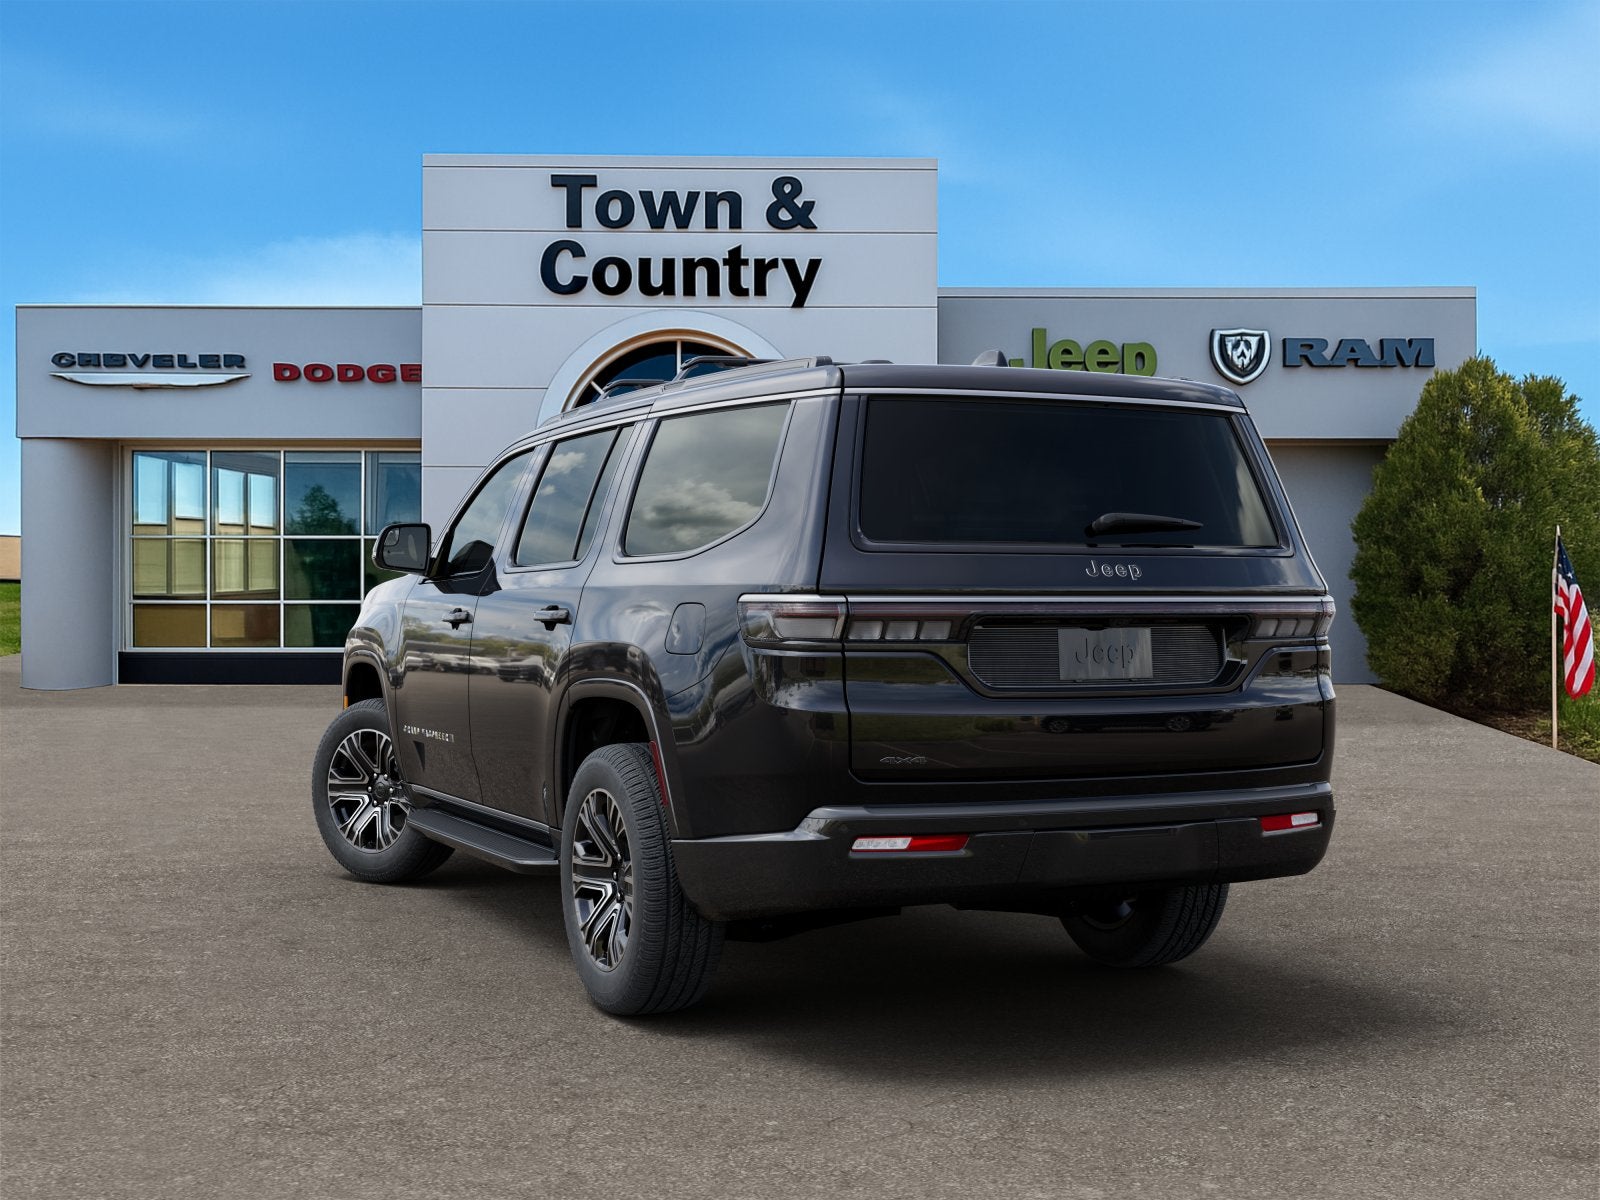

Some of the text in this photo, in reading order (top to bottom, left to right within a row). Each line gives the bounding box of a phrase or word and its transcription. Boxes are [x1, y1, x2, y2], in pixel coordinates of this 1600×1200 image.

[550, 174, 818, 230] Town &
[540, 239, 822, 308] Country
[1282, 338, 1435, 367] RAM
[273, 363, 422, 383] DODGE
[1085, 560, 1142, 581] Jeep
[1075, 637, 1134, 669] Jeep
